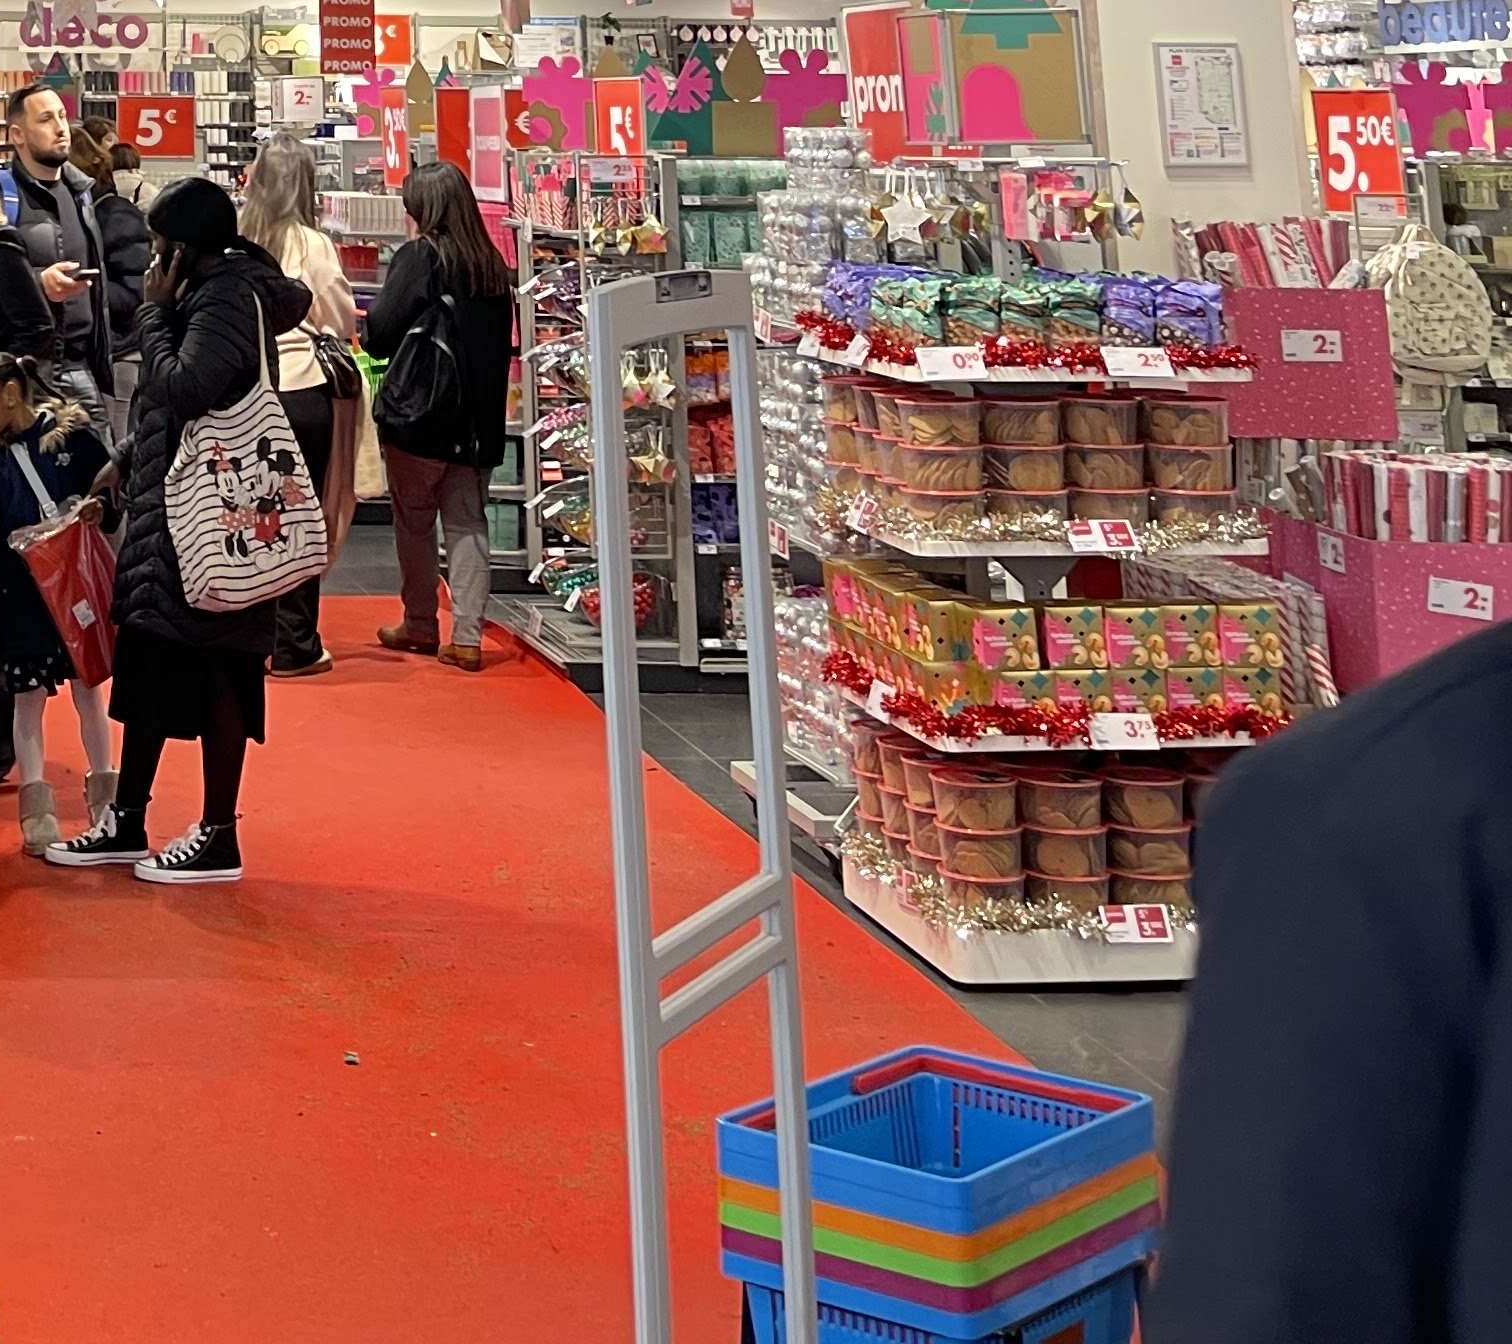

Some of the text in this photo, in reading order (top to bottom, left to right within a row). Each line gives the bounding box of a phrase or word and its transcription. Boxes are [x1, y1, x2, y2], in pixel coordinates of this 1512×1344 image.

[323, 16, 372, 27] PROMO
[323, 38, 372, 49] PROMO
[324, 60, 373, 71] PROMO
[135, 108, 177, 147] 5€
